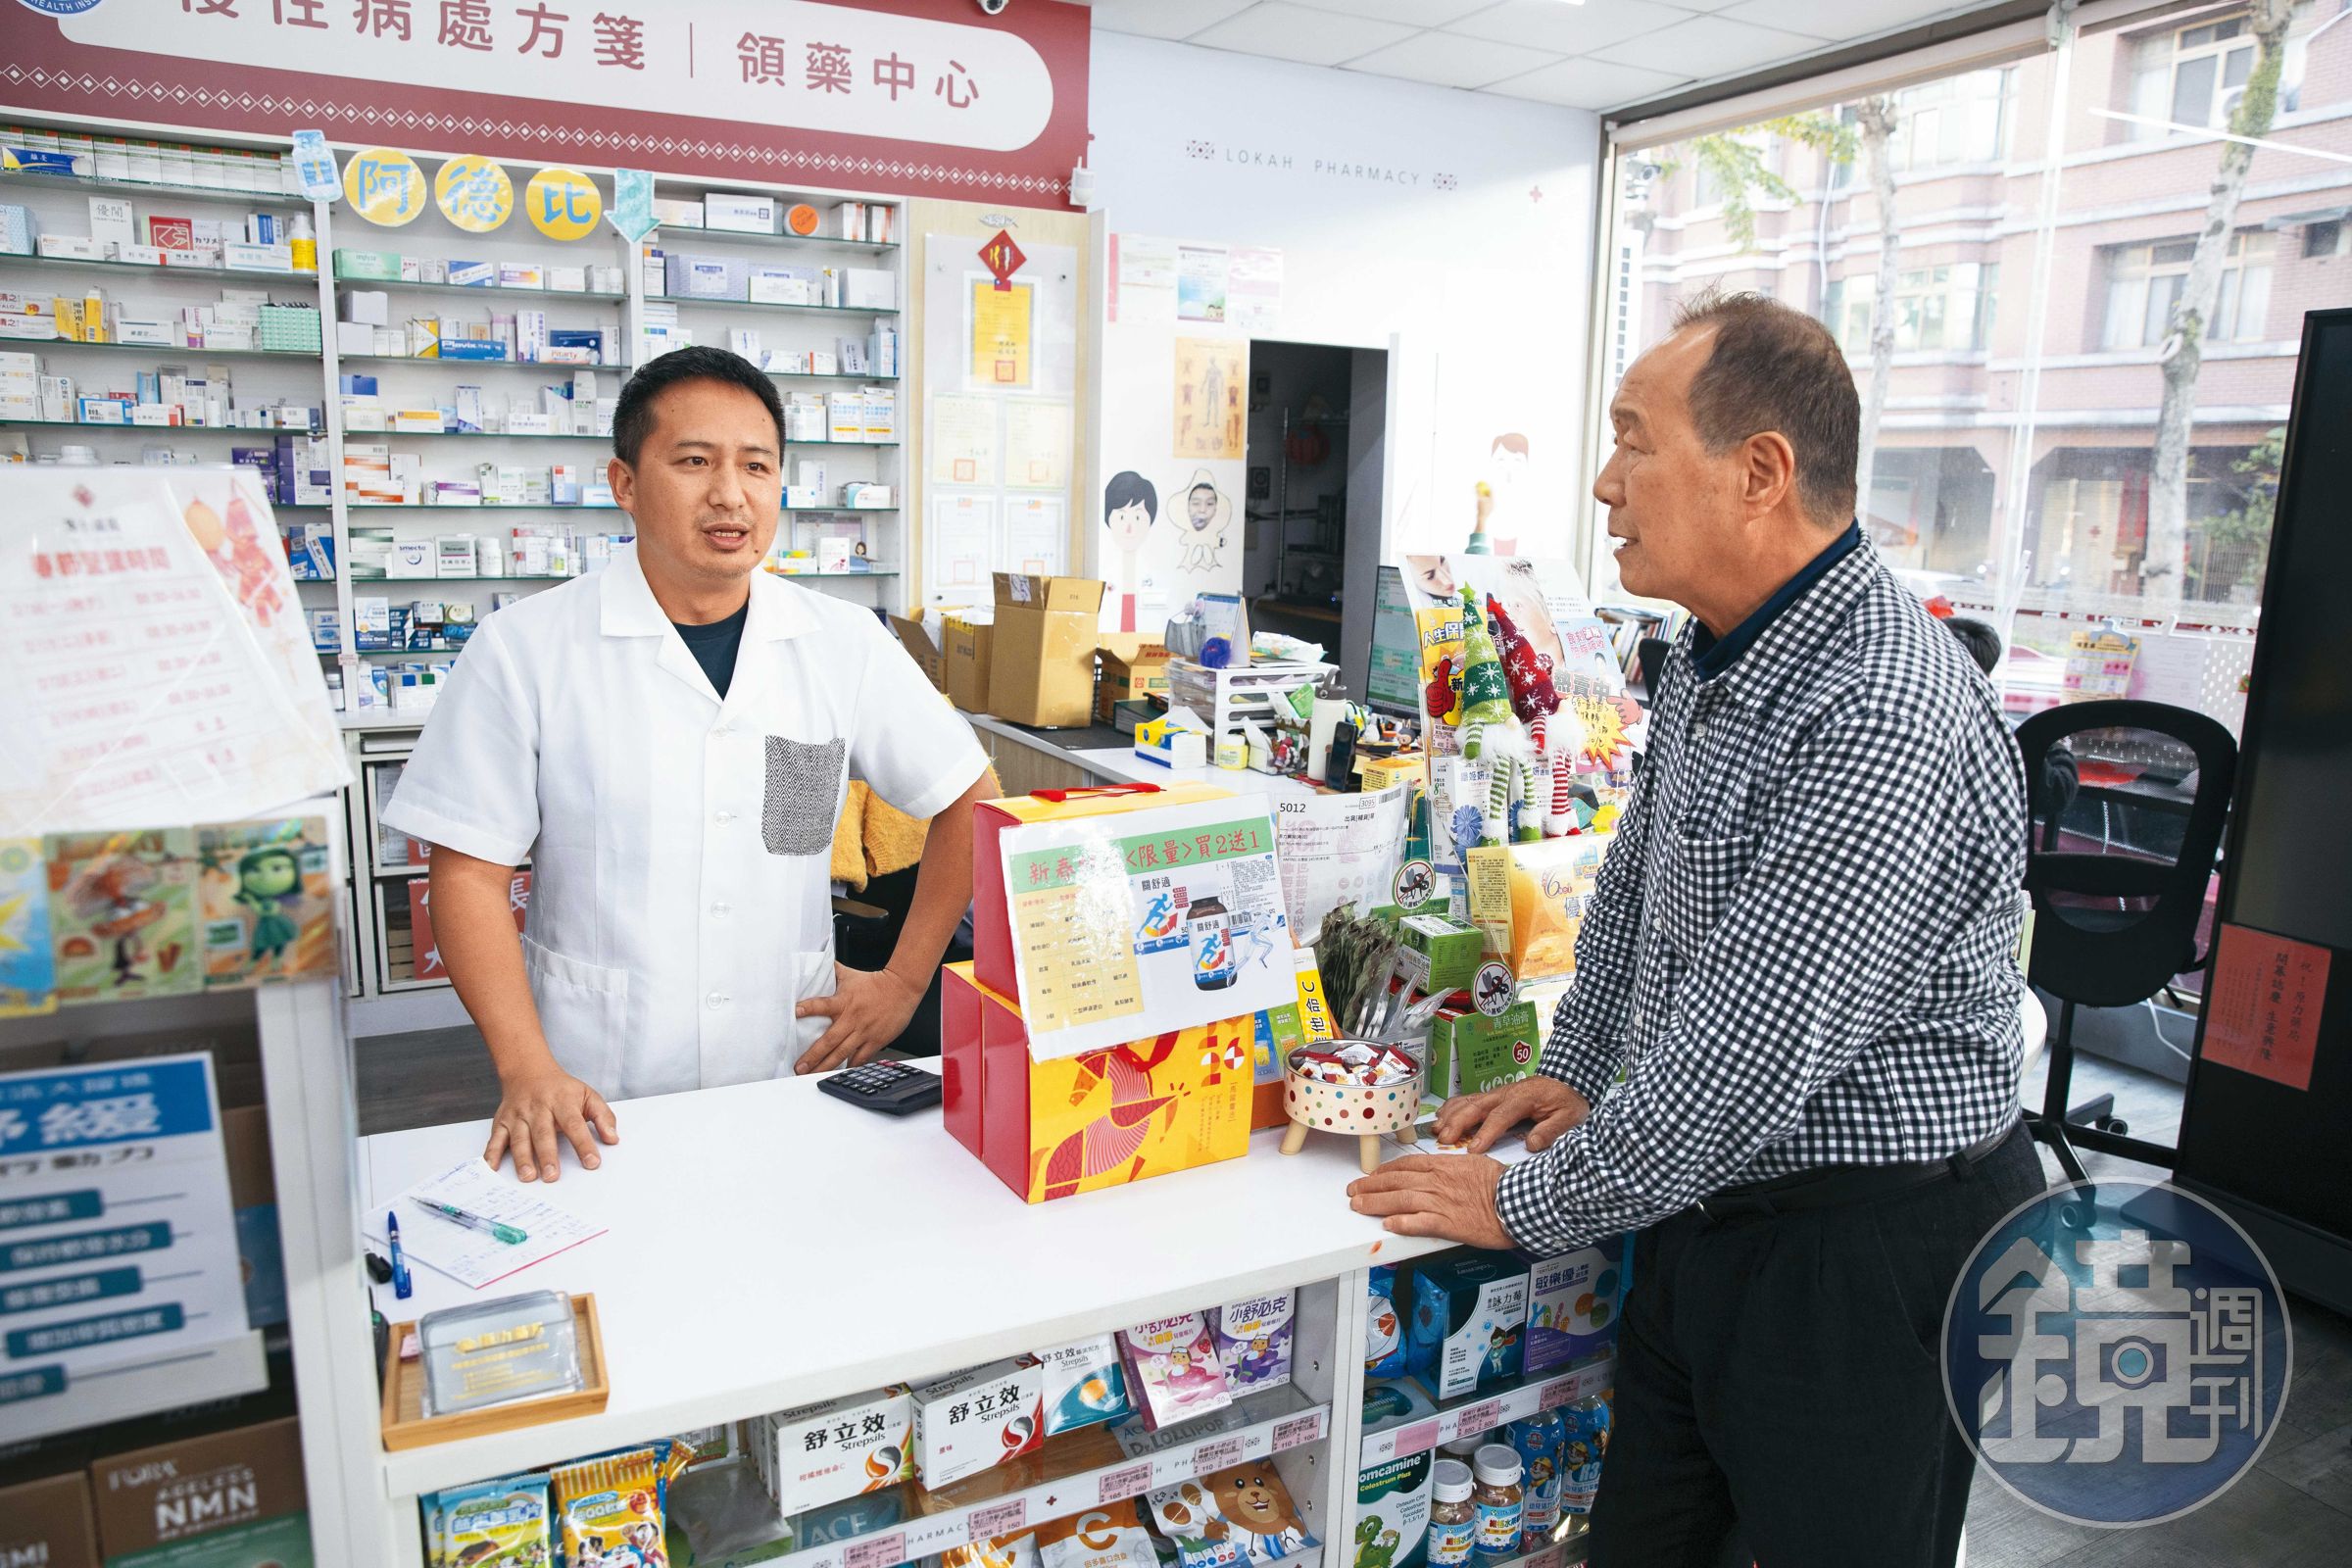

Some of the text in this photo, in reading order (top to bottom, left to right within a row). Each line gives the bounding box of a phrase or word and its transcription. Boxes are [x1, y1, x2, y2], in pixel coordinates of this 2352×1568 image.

[736, 31, 979, 109] 領藥中心
[1225, 148, 1419, 185] LOKAH PHARMACY
[442, 340, 476, 350] Plavix
[1424, 621, 1464, 649] 人生保
[1280, 804, 1305, 812] 5012
[1142, 876, 1171, 891] 關舒適
[1516, 1049, 1529, 1060] 50
[1535, 1267, 1576, 1290] 敏樂優
[1230, 1297, 1288, 1323] 小舒必克
[1042, 1348, 1074, 1363] 舒立效
[1061, 1355, 1089, 1367] Strepsils
[925, 1373, 975, 1396] Strepsils
[783, 1400, 837, 1419] Strepsils
[949, 1384, 1019, 1425] 舒立效
[980, 1403, 1020, 1424] Strepsils
[804, 1412, 886, 1452] 舒立效
[841, 1432, 886, 1452] Strepsils
[1359, 1471, 1411, 1493] Colostrum Plus
[157, 1482, 258, 1530] NMN
